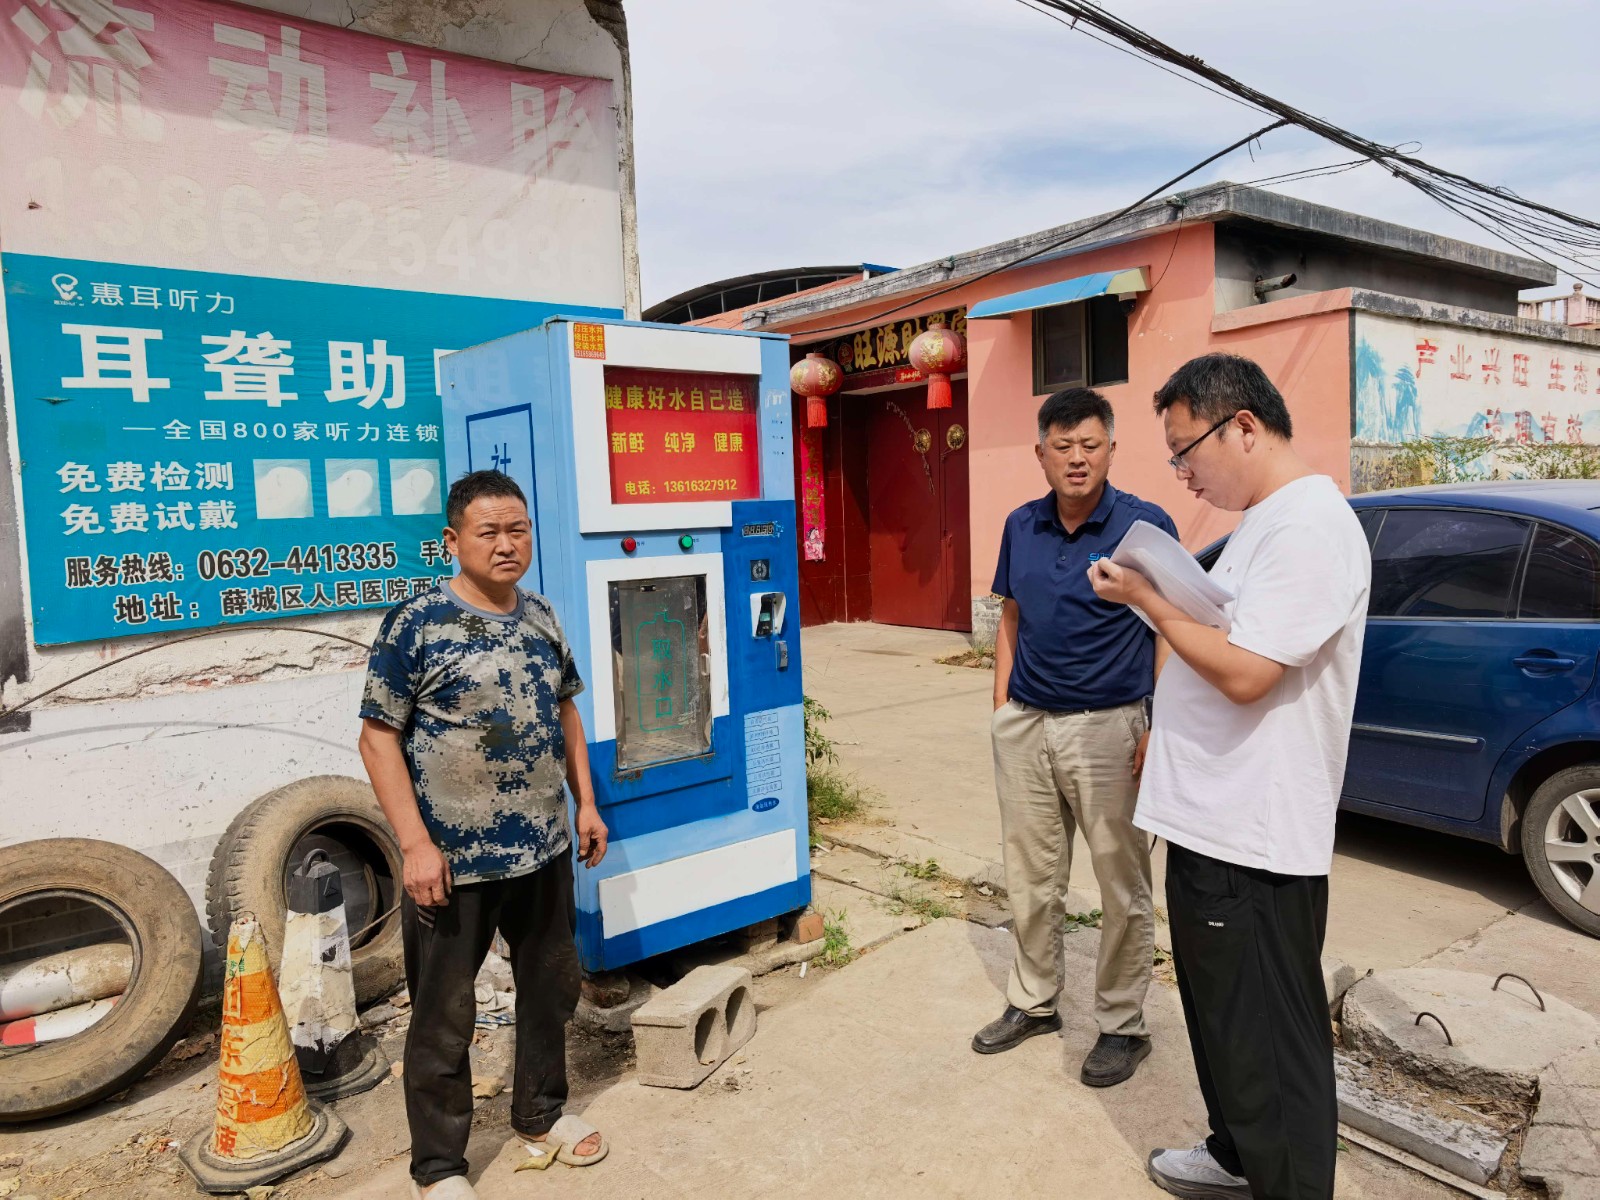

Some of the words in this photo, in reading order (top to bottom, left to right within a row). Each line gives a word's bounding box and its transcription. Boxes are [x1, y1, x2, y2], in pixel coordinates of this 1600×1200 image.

[90, 283, 235, 314] 惠耳听力
[61, 322, 445, 409] 耳聋助
[1547, 356, 1600, 395] 生态
[605, 384, 744, 411] 健康好水自己造
[611, 432, 645, 454] 新鲜
[664, 432, 696, 453] 纯净
[713, 432, 744, 453] 健康
[56, 461, 235, 494] 免费检测
[663, 479, 738, 493] 13616327912
[60, 500, 239, 536] 免费试戴
[198, 541, 398, 581] 0632-4413335
[220, 575, 453, 617] 薛城区人民医院西
[651, 638, 673, 719] 取水口
